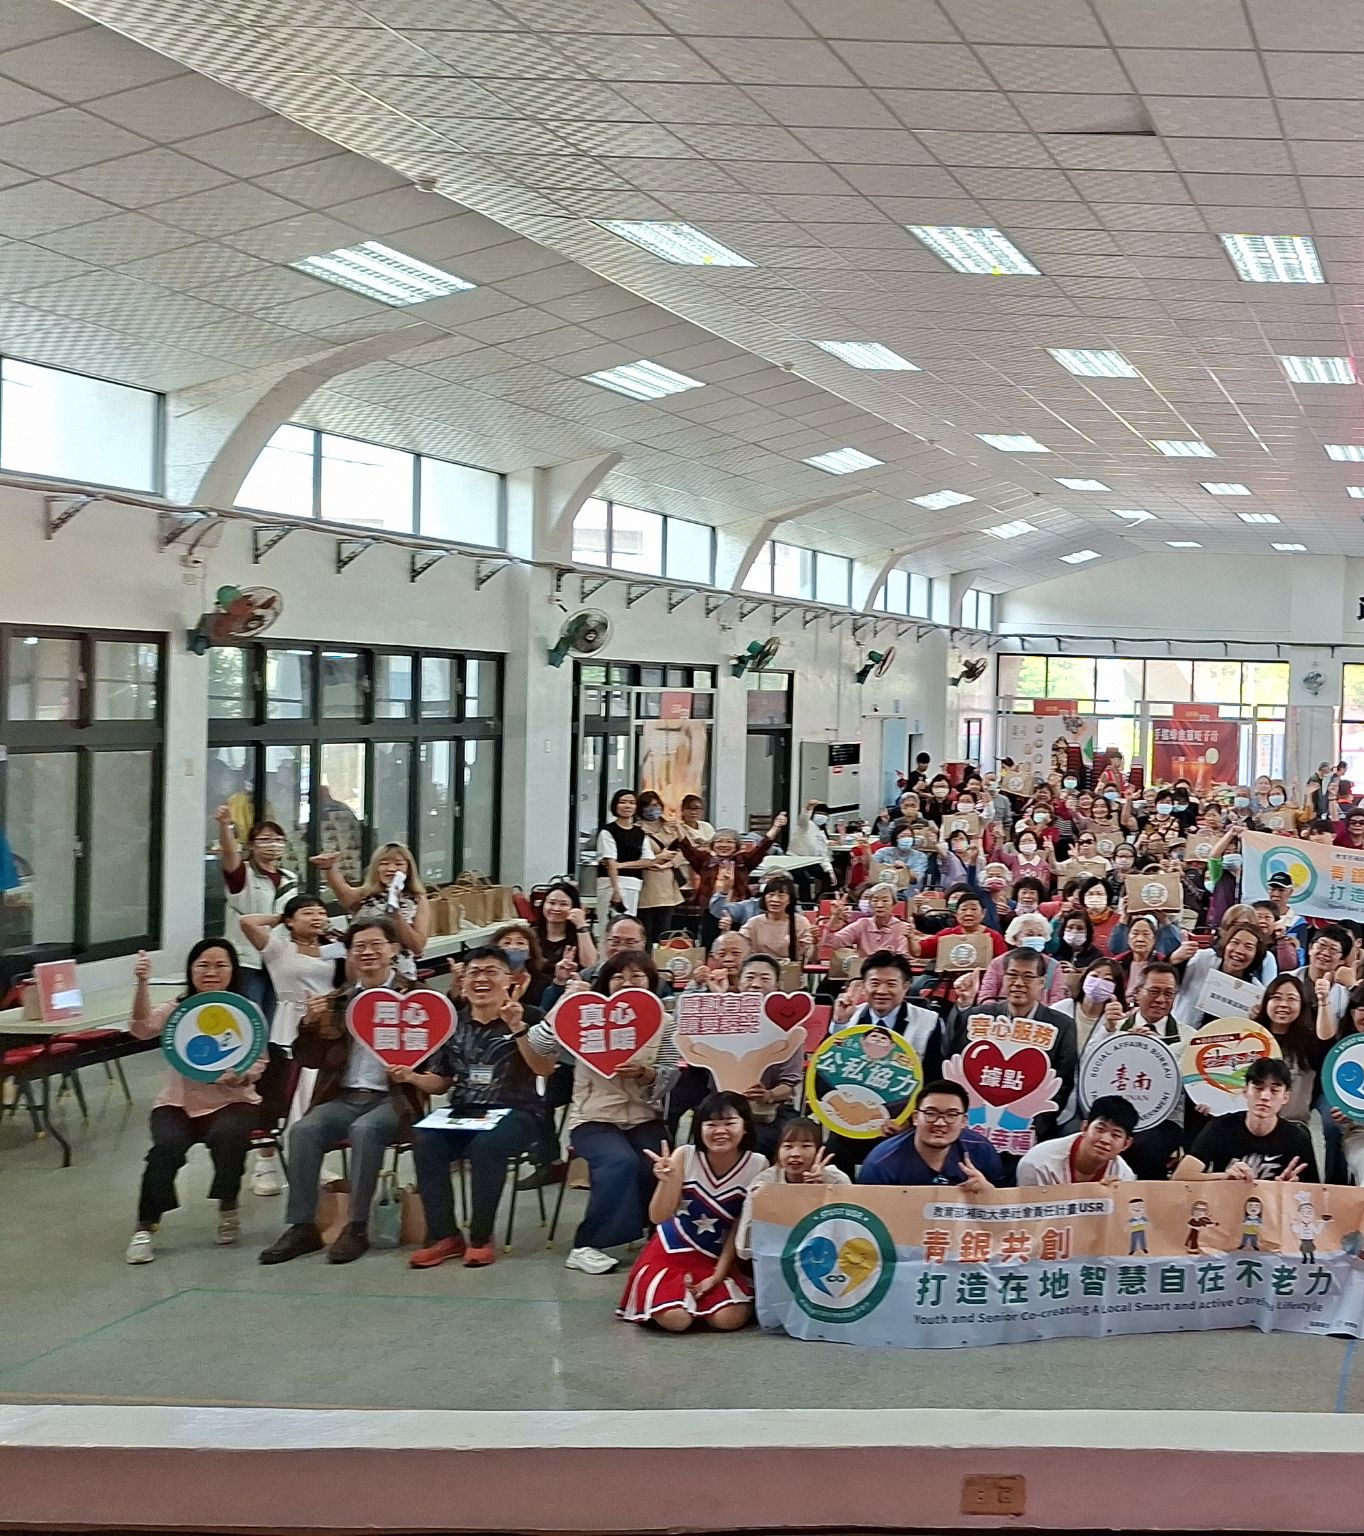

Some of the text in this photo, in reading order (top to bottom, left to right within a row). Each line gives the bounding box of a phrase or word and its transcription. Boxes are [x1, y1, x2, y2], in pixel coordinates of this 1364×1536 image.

[578, 1001, 637, 1028] 真心
[816, 1050, 919, 1097] 公私協力
[923, 1228, 1072, 1264] 青銀共創
[916, 1259, 1333, 1307] 打造在地智慧自在不老力
[914, 1314, 948, 1325] Youth
[951, 1313, 975, 1323] and
[978, 1312, 1018, 1323] Senior
[1020, 1305, 1090, 1321] Co-creating
[1101, 1302, 1132, 1314] Local
[1135, 1302, 1171, 1312] Smart
[1173, 1300, 1196, 1310] and
[1199, 1299, 1233, 1310] Active
